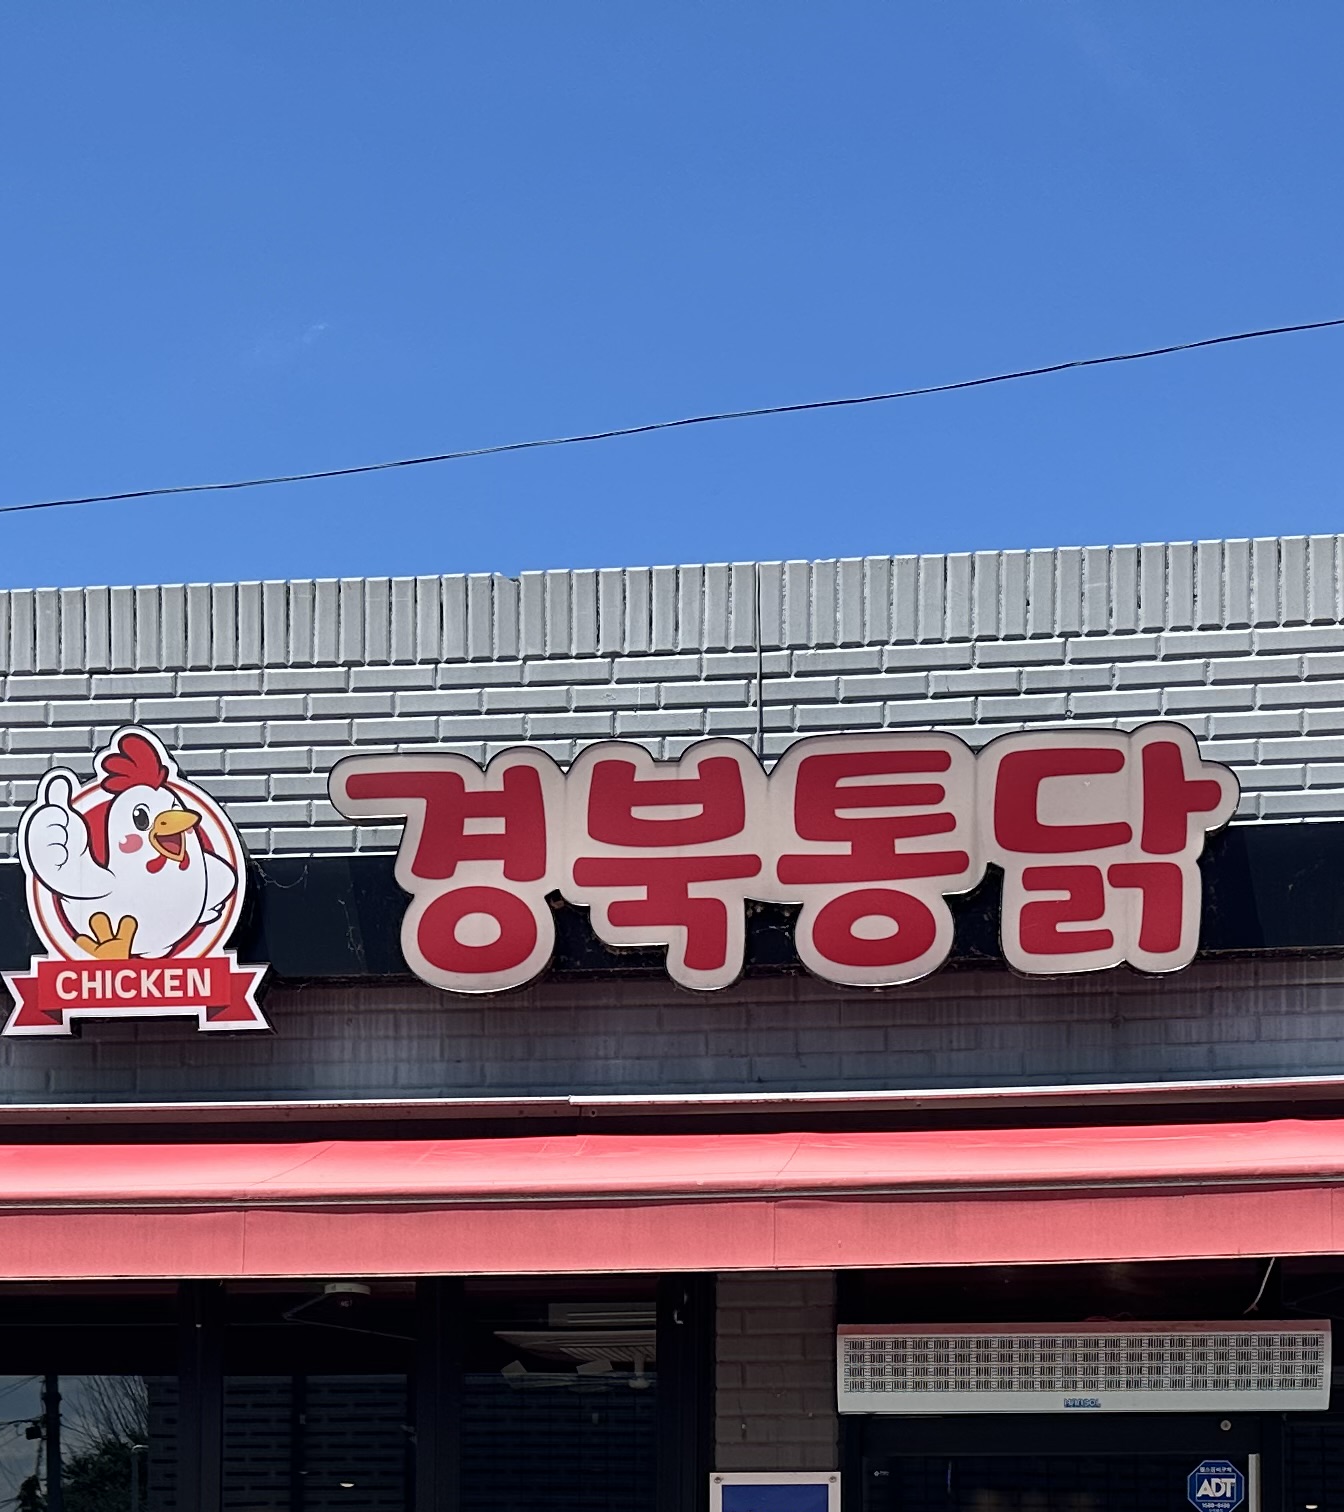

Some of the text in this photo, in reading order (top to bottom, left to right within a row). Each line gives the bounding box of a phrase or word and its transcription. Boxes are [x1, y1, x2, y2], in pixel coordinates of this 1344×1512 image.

[345, 740, 1223, 976] 경북통닭
[54, 966, 213, 1002] CHICKEN
[1196, 1477, 1236, 1498] ADT
